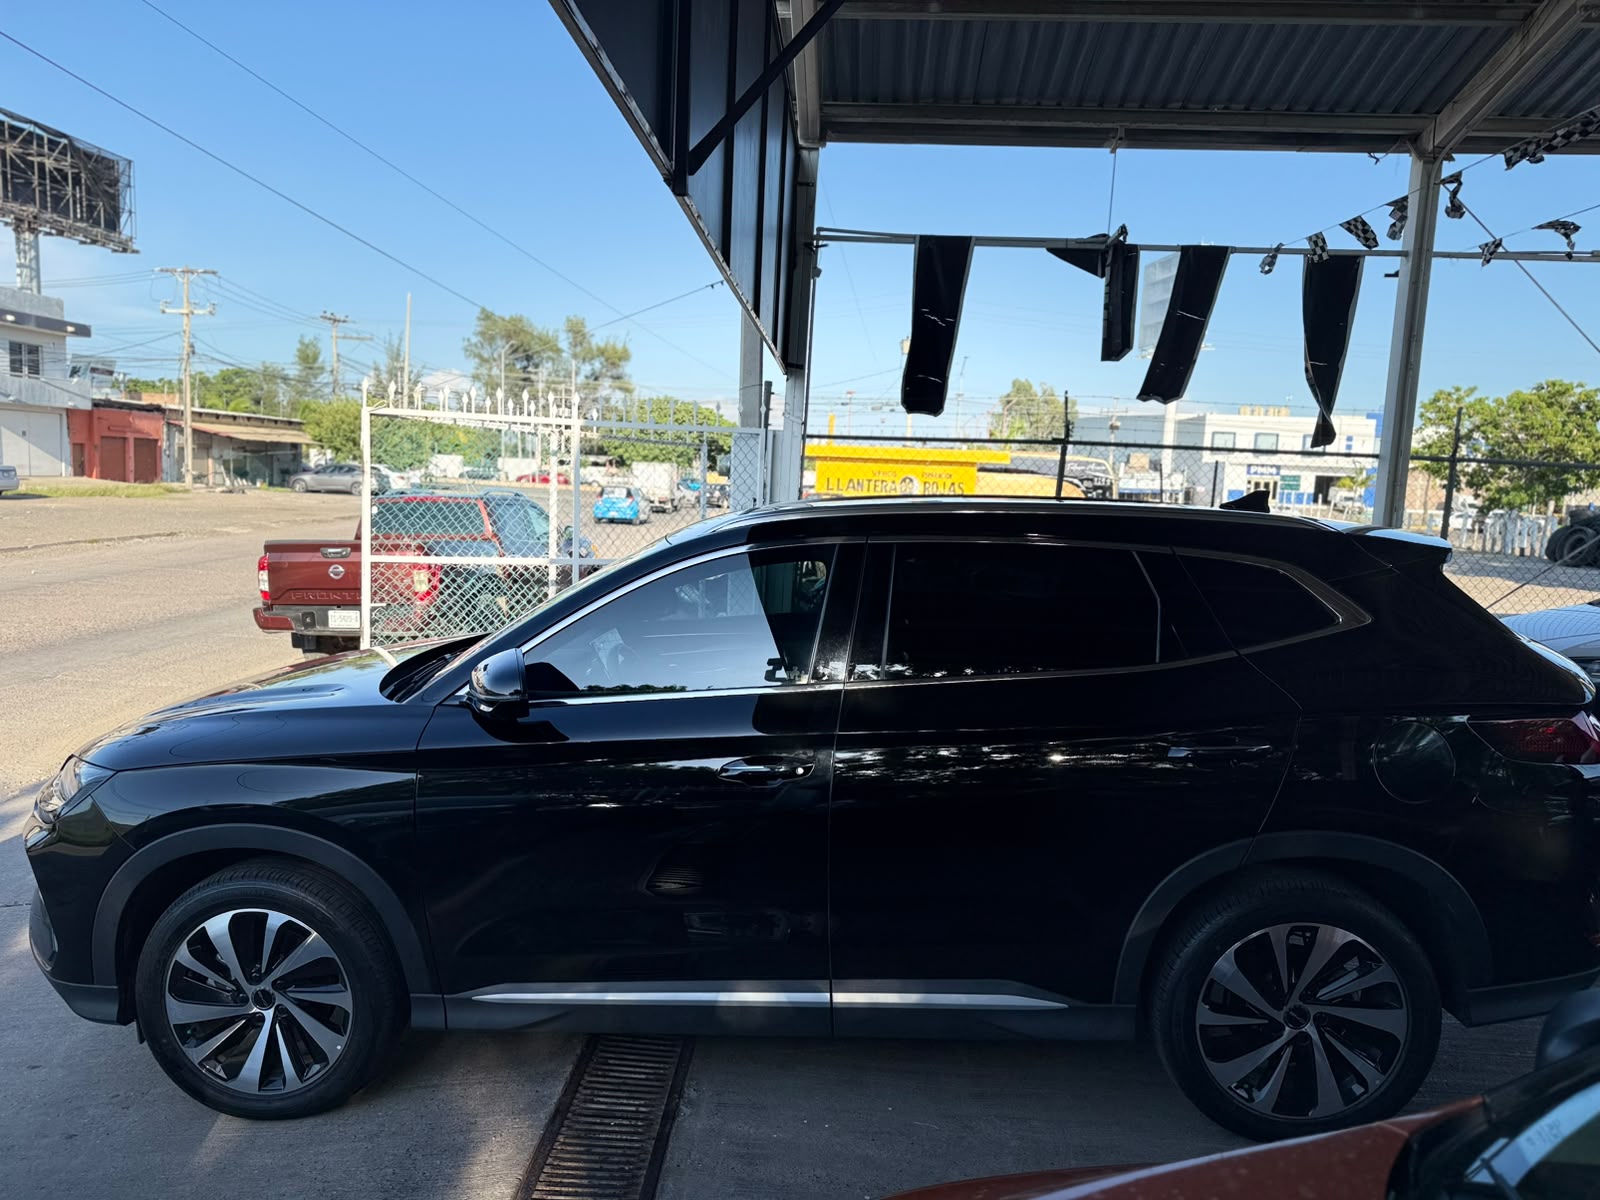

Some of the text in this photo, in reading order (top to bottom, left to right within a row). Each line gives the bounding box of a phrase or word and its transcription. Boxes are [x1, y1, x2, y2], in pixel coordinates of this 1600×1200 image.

[826, 478, 964, 495] LLANTERA ROJAS
[291, 592, 361, 600] FRONTI
